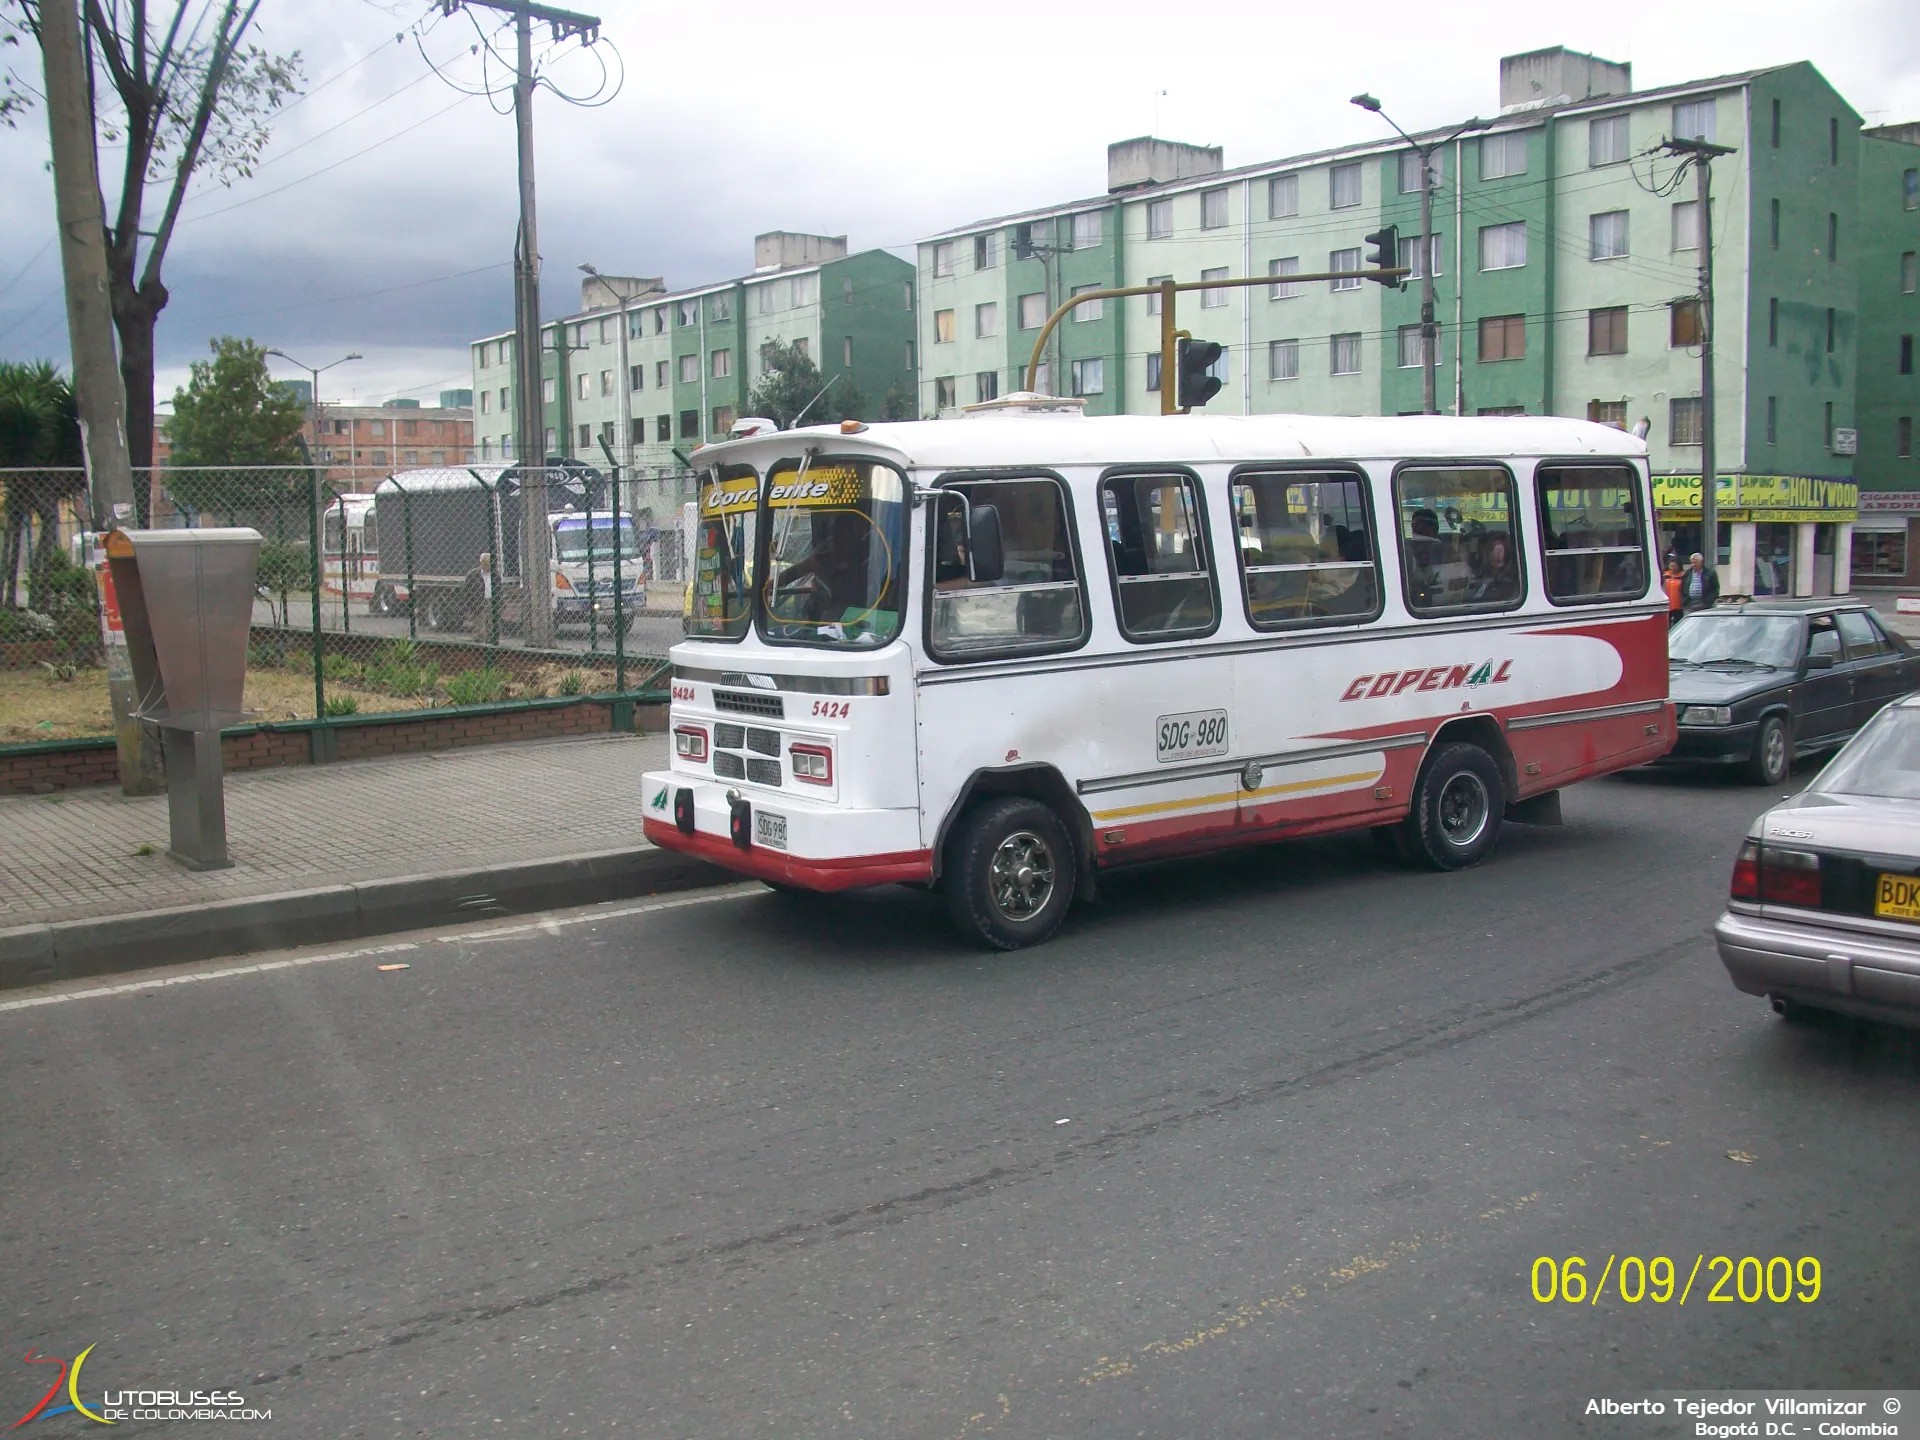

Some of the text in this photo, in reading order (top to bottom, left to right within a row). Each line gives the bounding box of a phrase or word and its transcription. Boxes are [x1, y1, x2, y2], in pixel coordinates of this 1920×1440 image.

[1790, 476, 1859, 508] HOLLYWOOD
[1340, 658, 1513, 702] COPENAL
[812, 700, 851, 719] 5424
[1158, 716, 1226, 752] SDG 980
[758, 818, 788, 841] SDG 980
[1771, 827, 1814, 839] RACER
[1881, 879, 1920, 908] BDK
